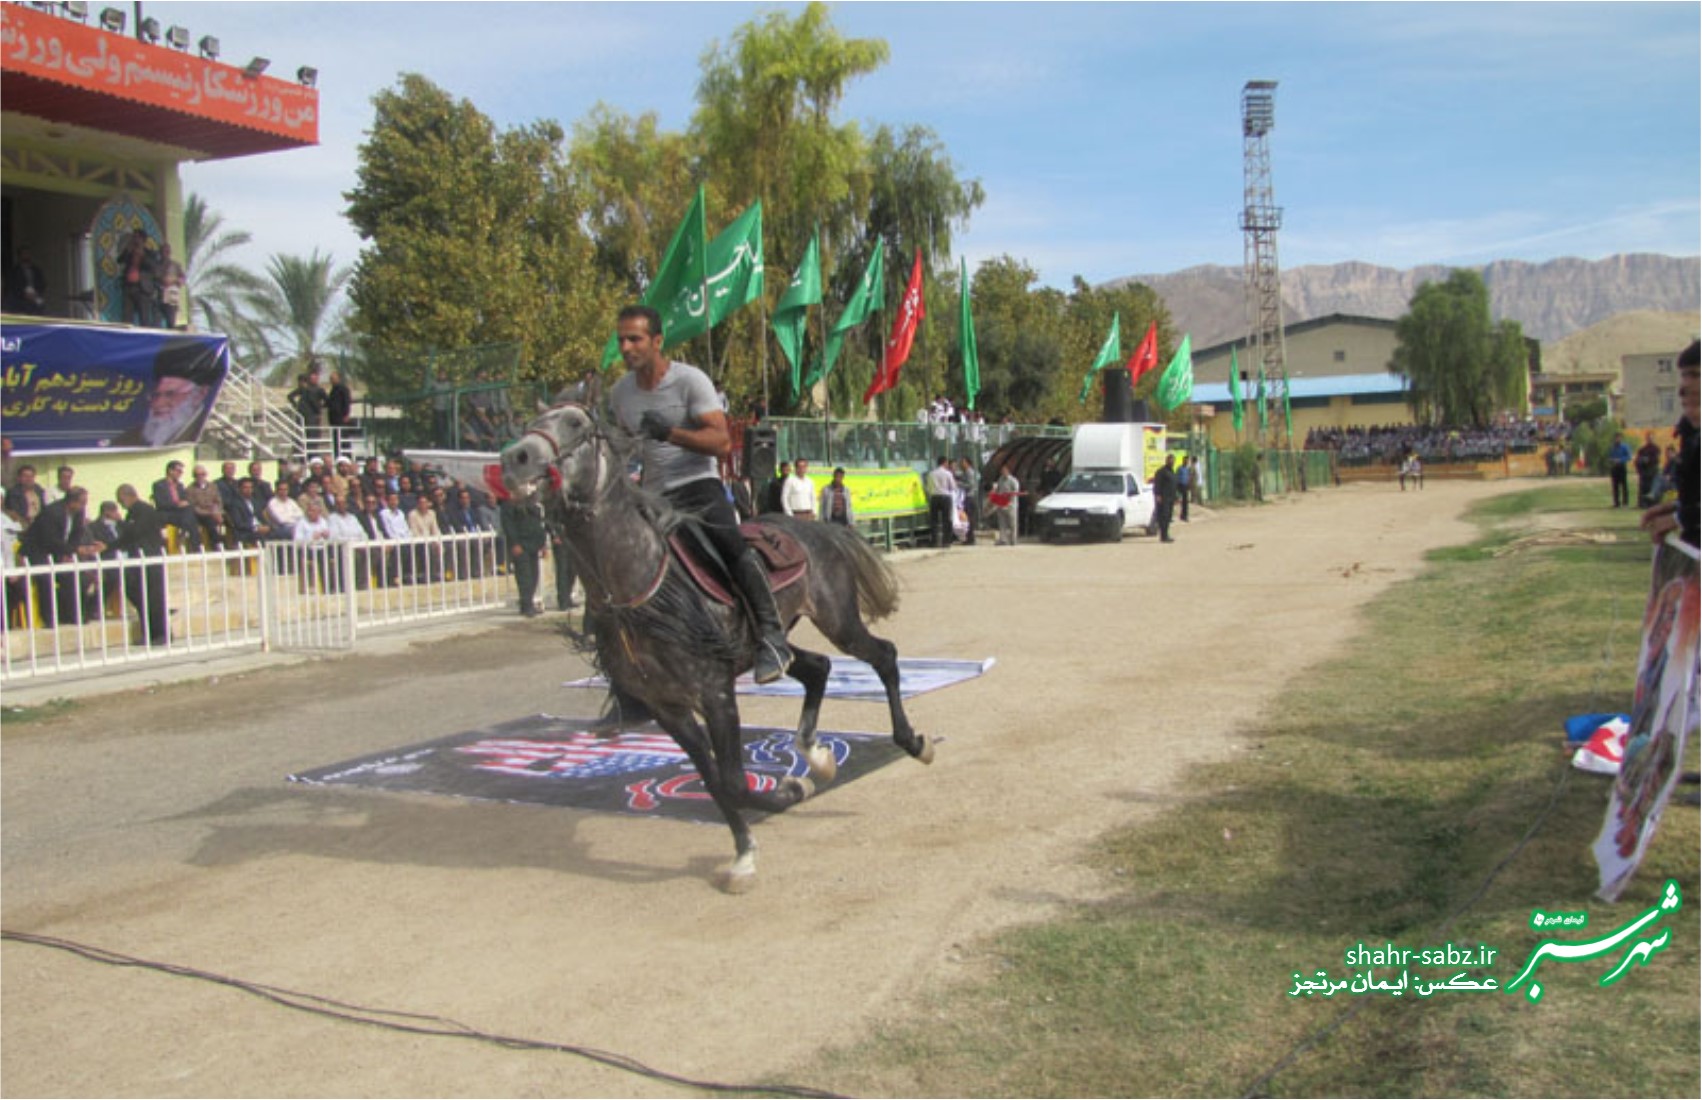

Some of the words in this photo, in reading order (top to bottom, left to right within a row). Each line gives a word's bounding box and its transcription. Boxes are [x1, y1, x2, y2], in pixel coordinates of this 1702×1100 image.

[66, 35, 121, 84] ولی
[124, 53, 193, 99] نیستم
[186, 66, 282, 123] ورزشکار
[285, 104, 314, 128] من
[34, 373, 108, 393] سیزدهم
[107, 374, 143, 395] روز
[52, 400, 68, 415] به
[70, 399, 110, 412] دست
[112, 397, 135, 412] که
